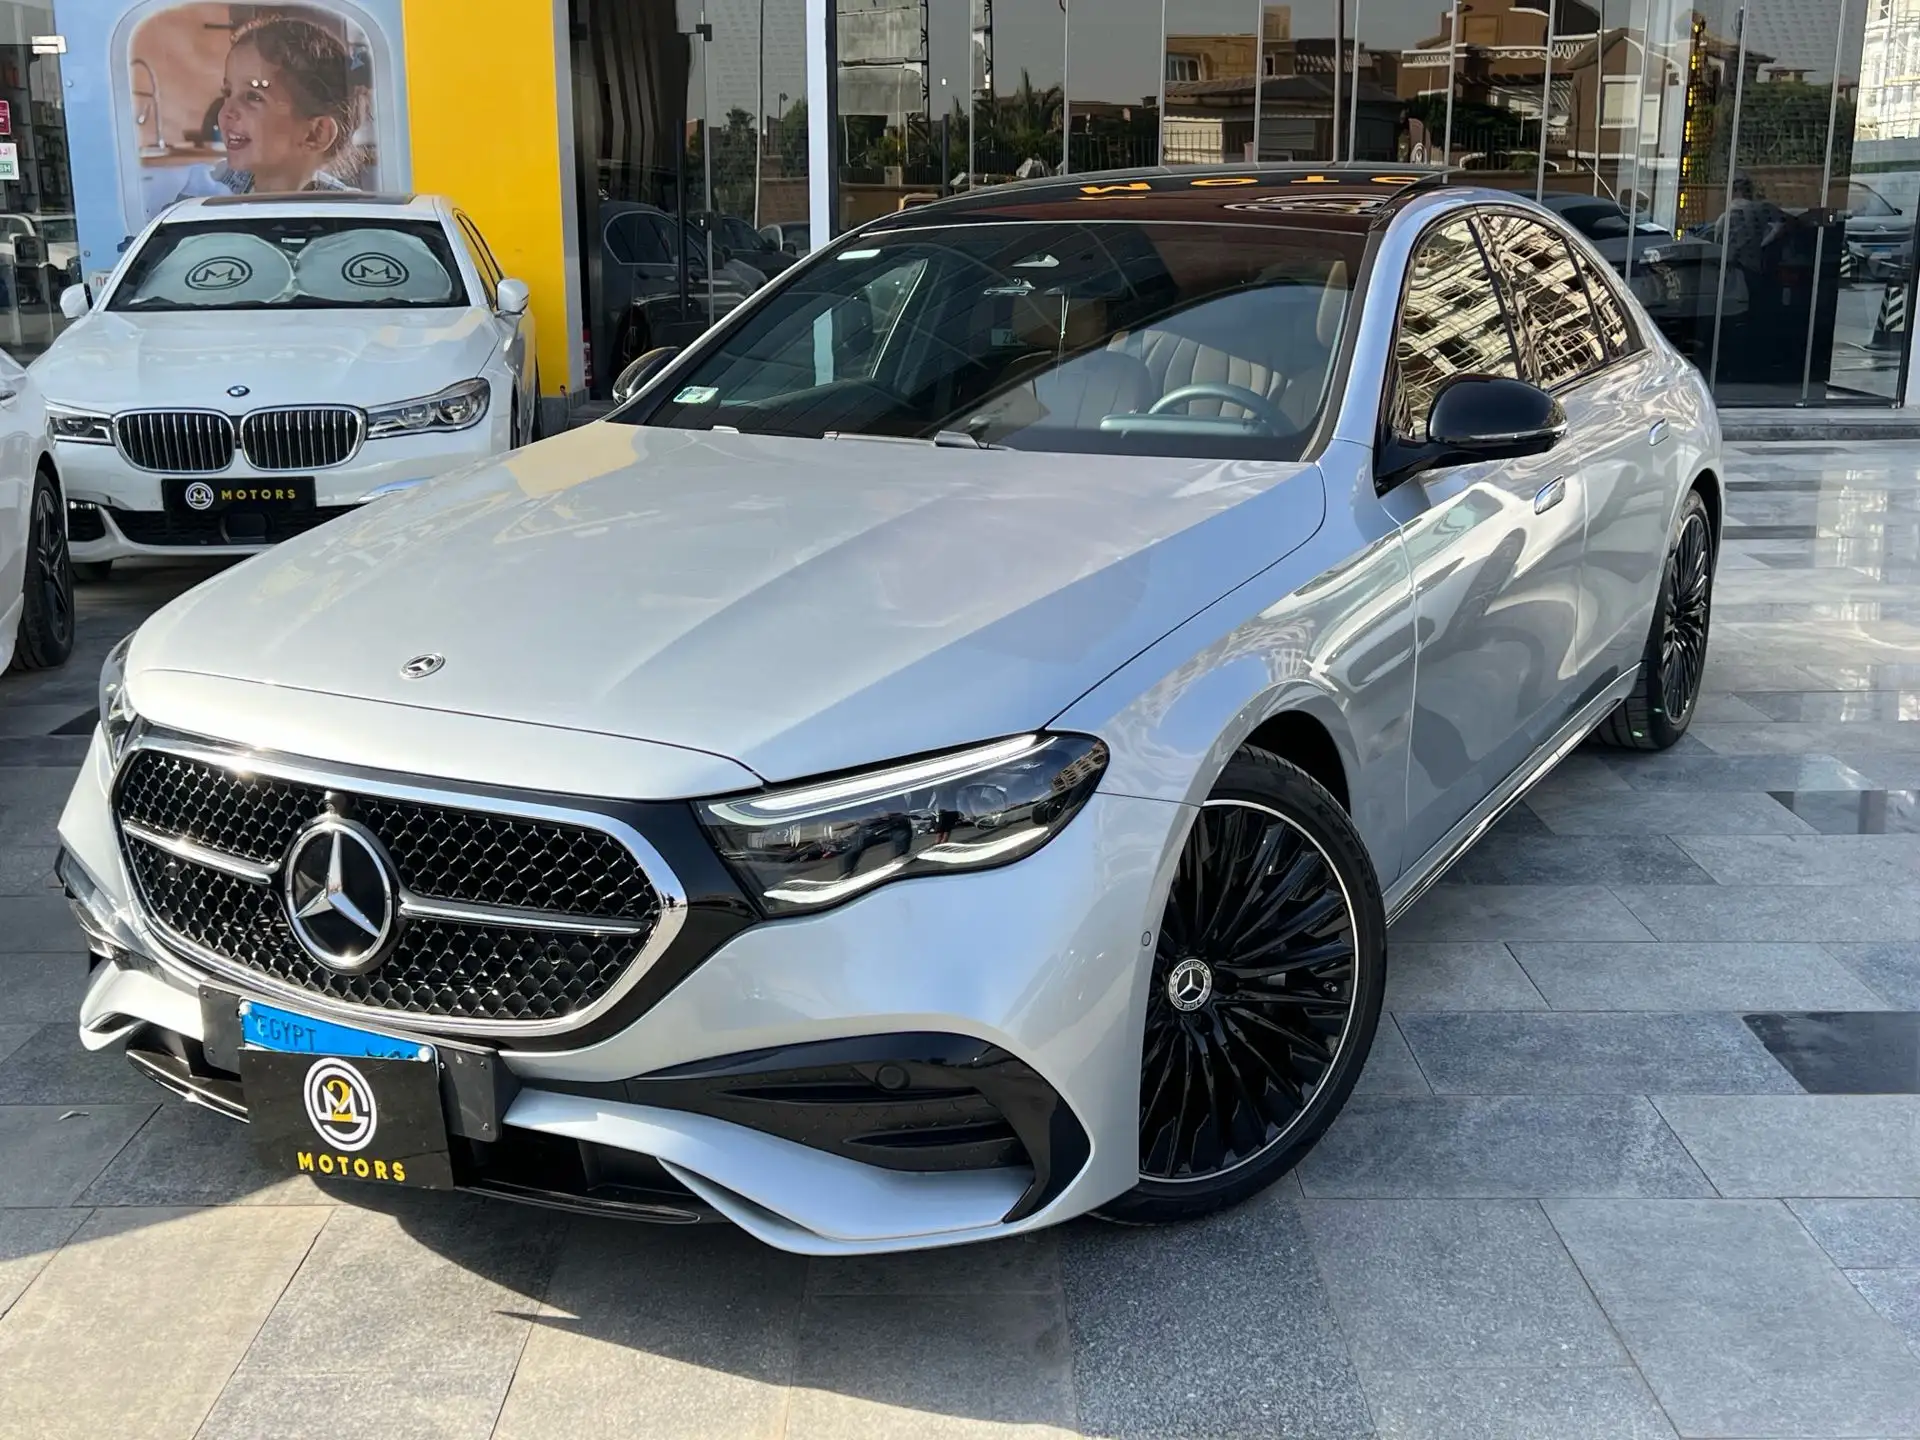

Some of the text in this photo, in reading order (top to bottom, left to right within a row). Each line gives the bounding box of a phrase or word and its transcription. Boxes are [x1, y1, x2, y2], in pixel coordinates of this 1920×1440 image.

[221, 489, 296, 501] MOTORS
[256, 1014, 317, 1052] EGYPT
[297, 1151, 406, 1182] MOTORS
